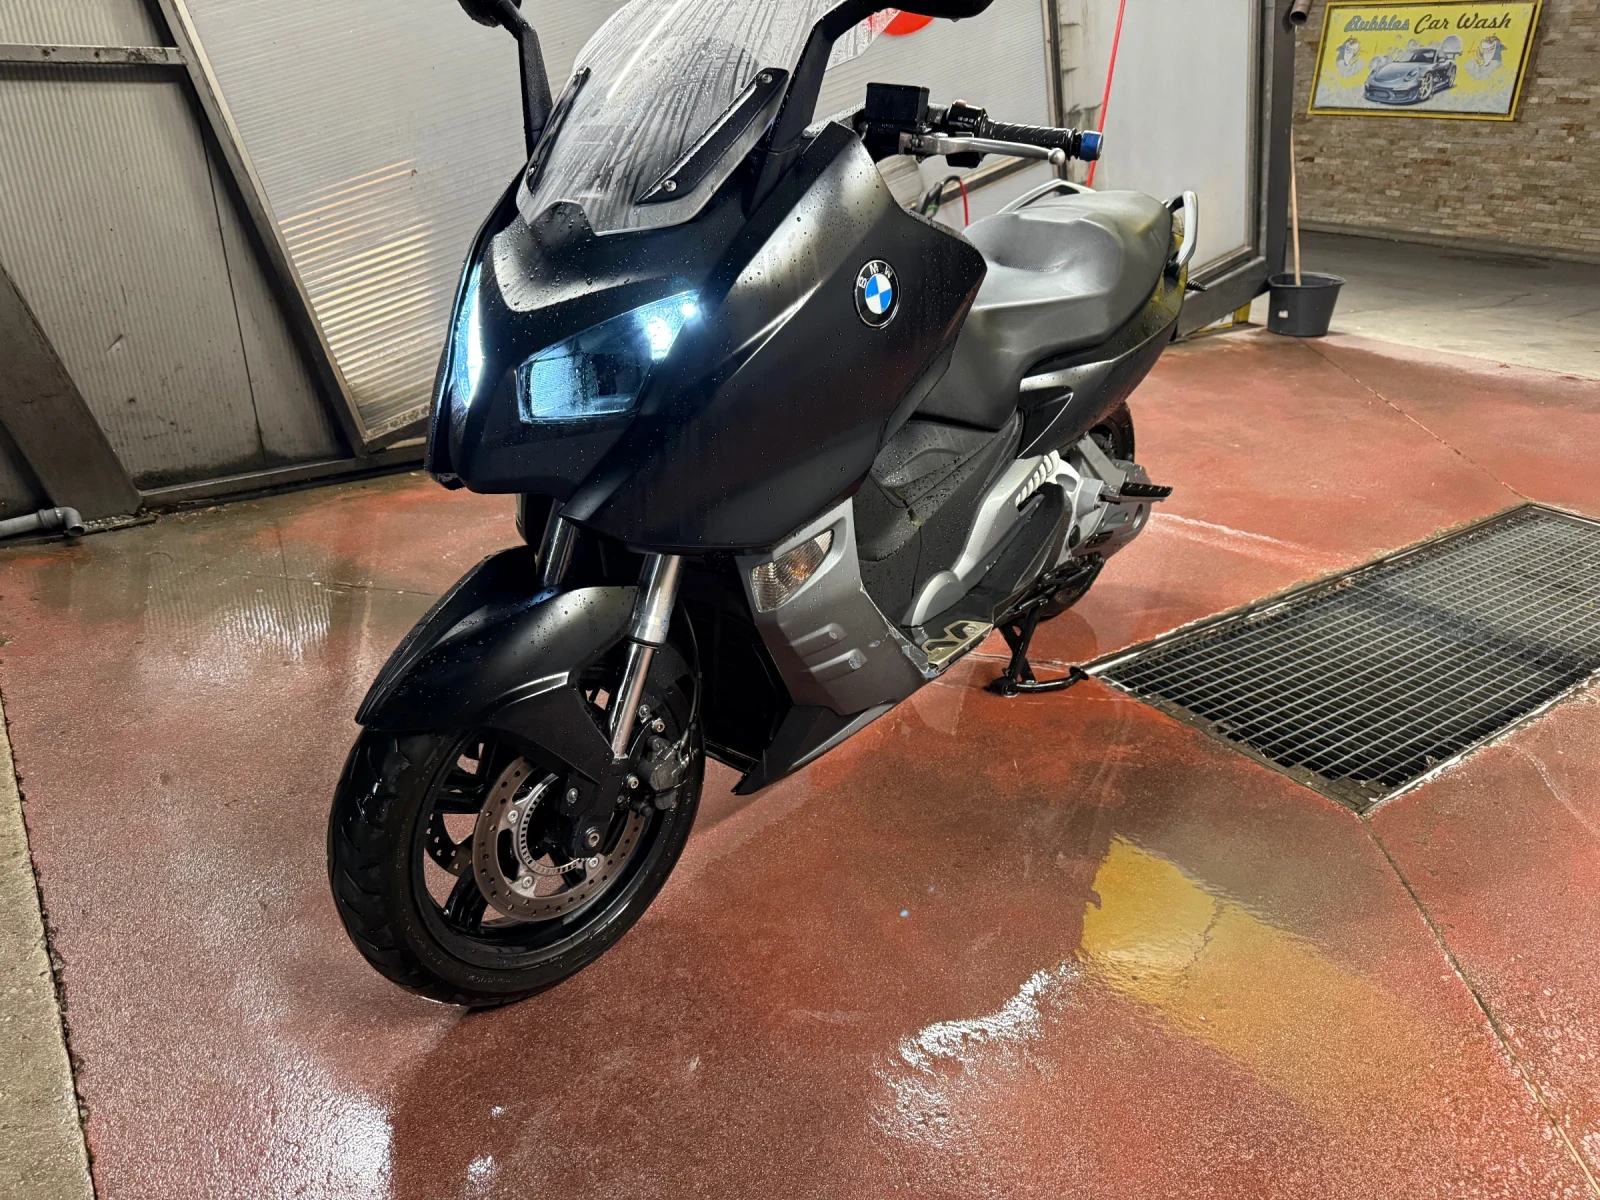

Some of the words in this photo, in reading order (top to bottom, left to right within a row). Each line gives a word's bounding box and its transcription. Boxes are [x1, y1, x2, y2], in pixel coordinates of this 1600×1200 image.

[1345, 15, 1410, 32] Bubbles
[1414, 14, 1449, 34] Car
[1457, 13, 1511, 30] Wash
[858, 262, 893, 289] BMW
